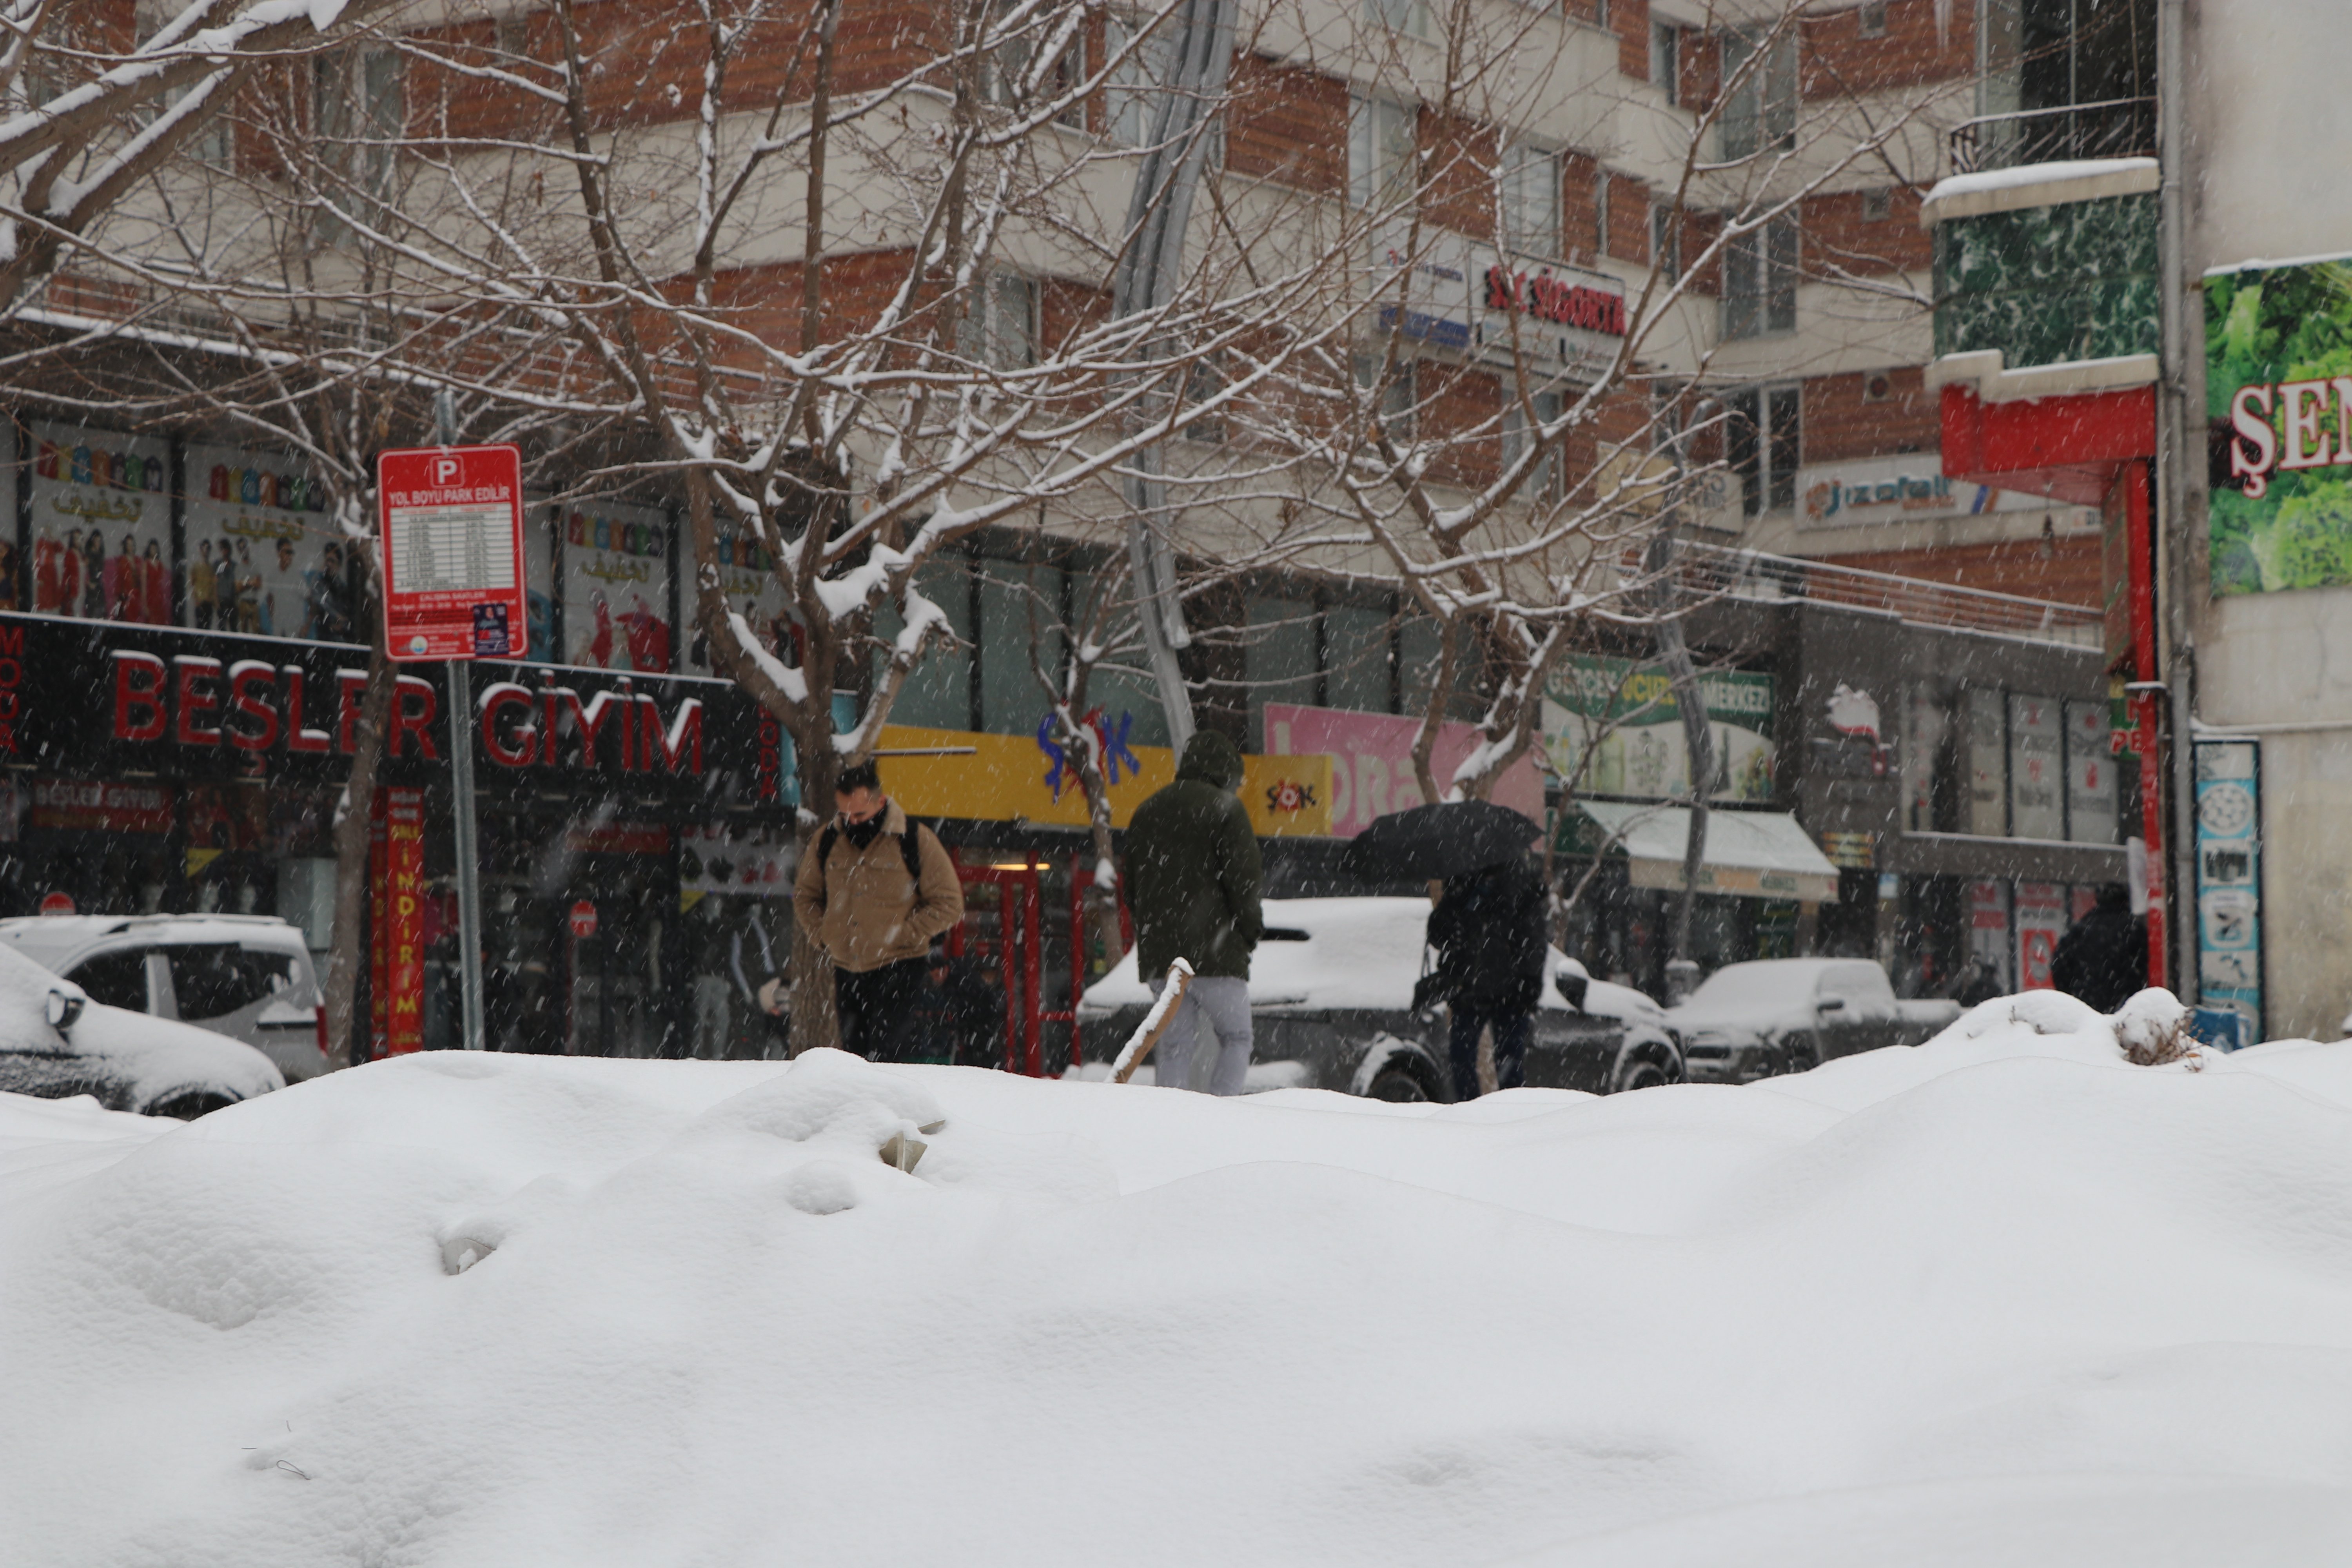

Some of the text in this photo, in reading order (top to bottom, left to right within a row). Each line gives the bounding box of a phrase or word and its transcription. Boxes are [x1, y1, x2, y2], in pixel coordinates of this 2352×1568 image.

[438, 460, 458, 484] P
[388, 483, 511, 506] YOL BOYU PARK EDİLİR
[111, 651, 703, 776] BEŞLER GİYİM
[1266, 783, 1317, 815] ŞOK
